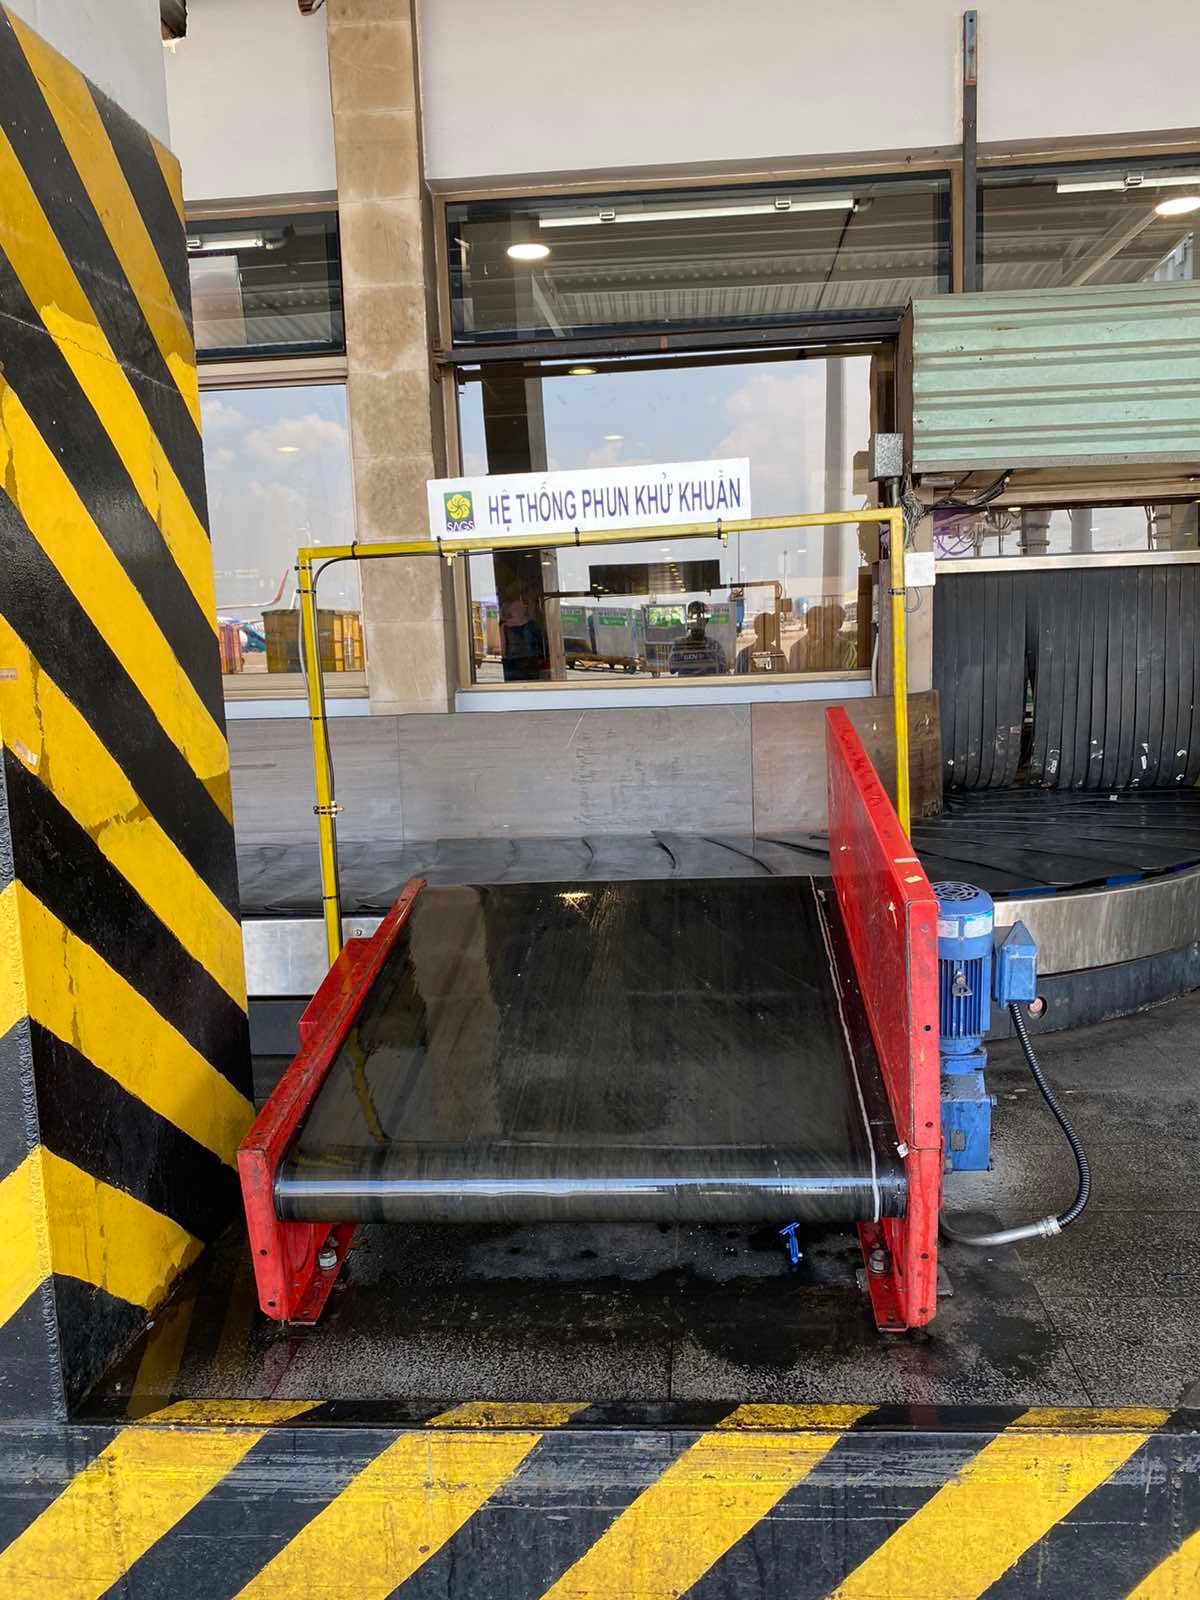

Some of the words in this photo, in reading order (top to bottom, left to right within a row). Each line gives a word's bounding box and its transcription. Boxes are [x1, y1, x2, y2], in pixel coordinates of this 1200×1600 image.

[488, 489, 512, 532] HỆ
[516, 481, 577, 521] THỐNG
[582, 486, 629, 518] PHUN
[635, 472, 673, 515] KHỬ
[447, 520, 475, 532] SAGS
